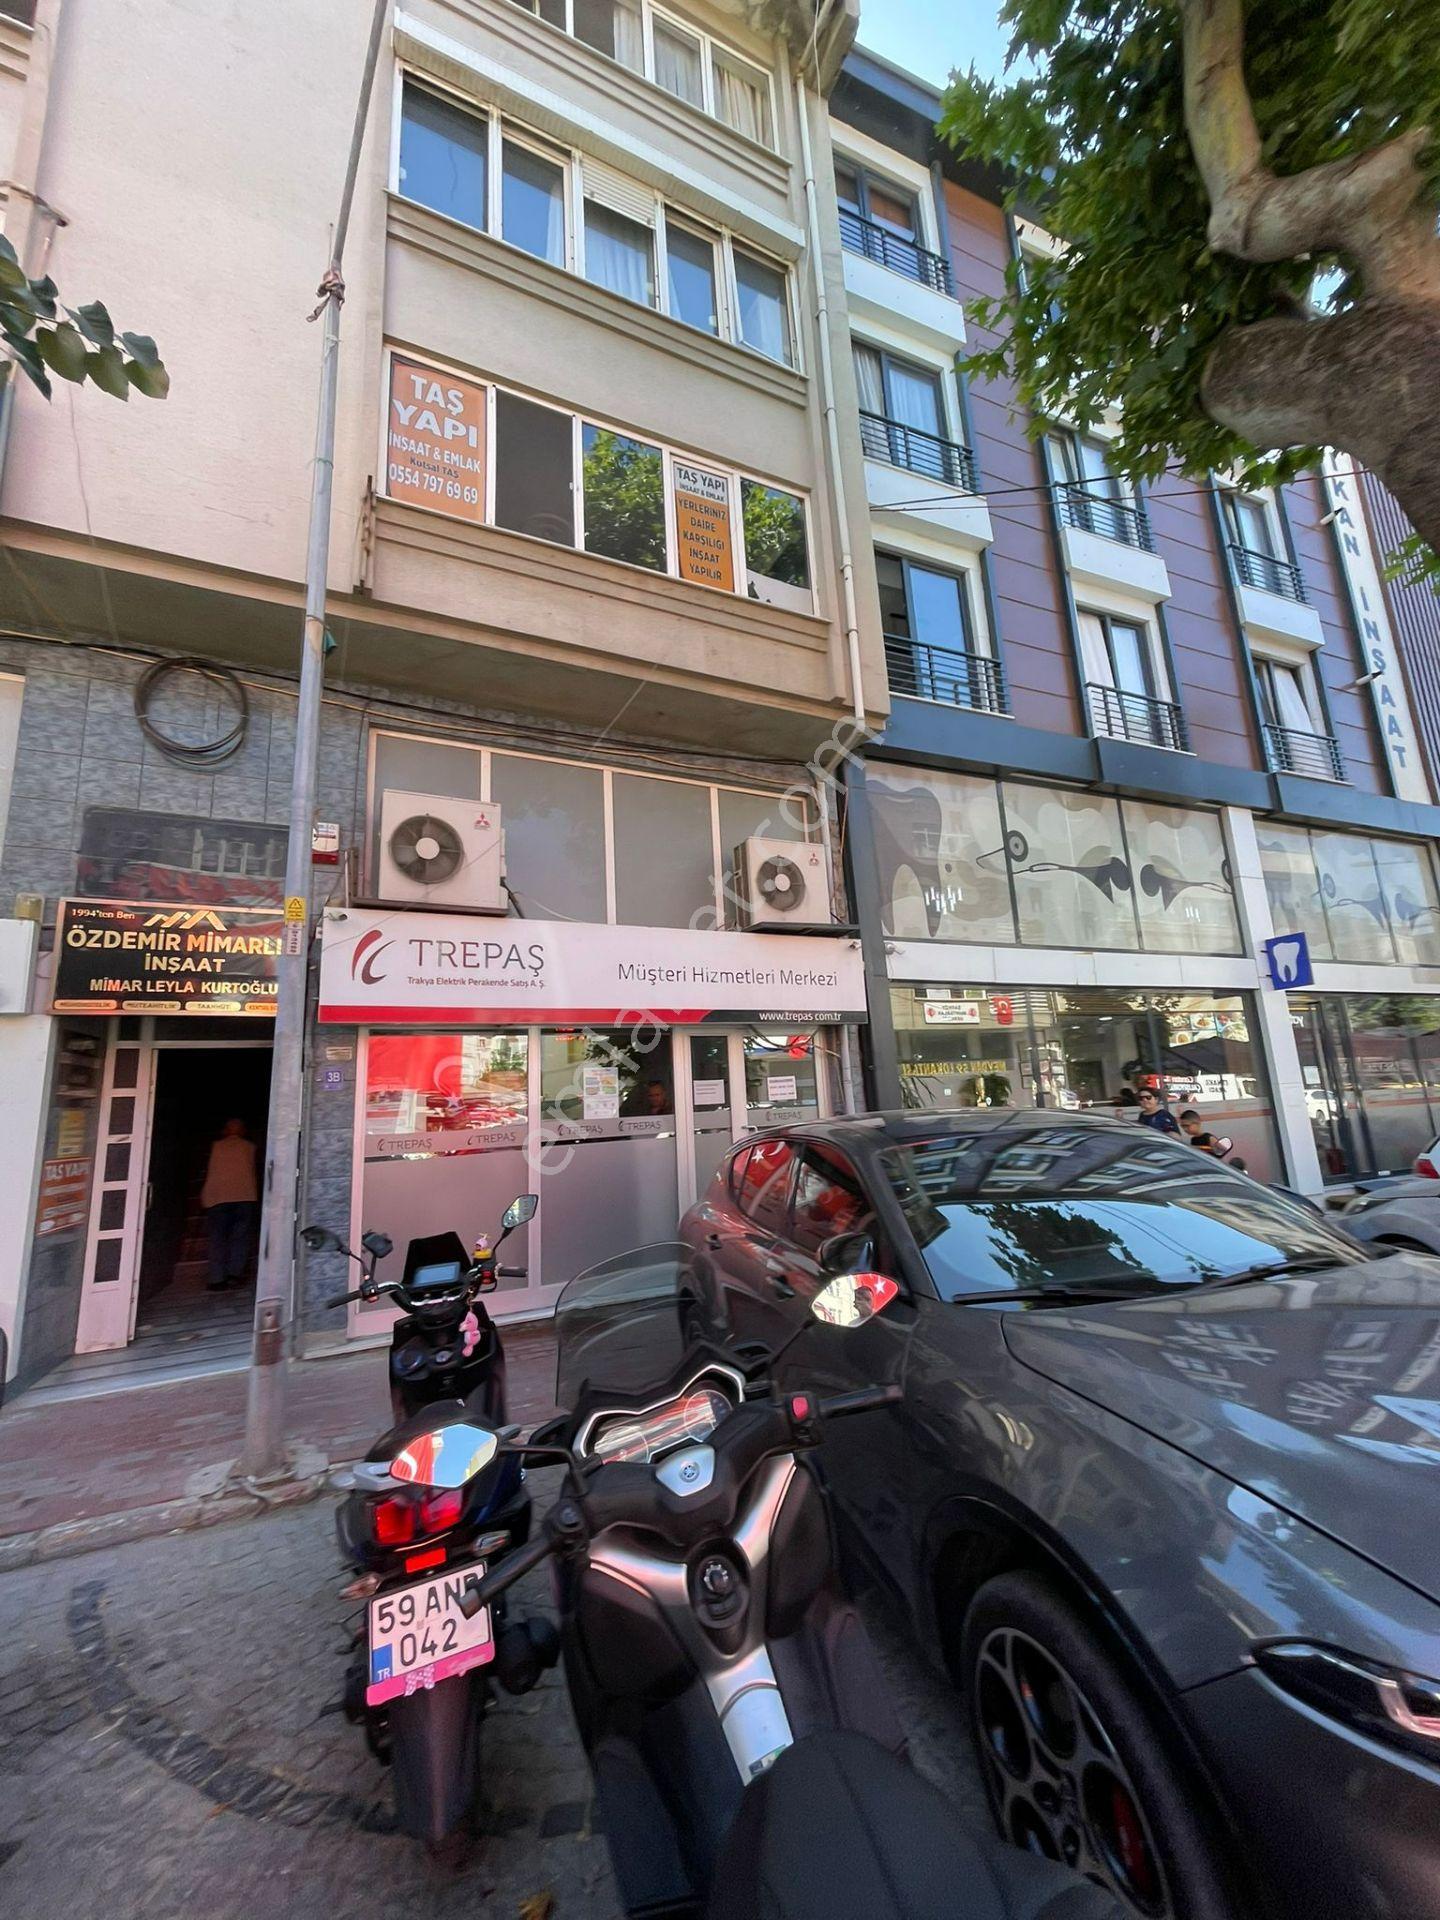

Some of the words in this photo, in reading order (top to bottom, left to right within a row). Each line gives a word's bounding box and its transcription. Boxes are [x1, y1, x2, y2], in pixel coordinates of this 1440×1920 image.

[410, 374, 465, 416] TAŞ
[392, 399, 478, 448] YAPI
[433, 446, 441, 461] &
[443, 450, 481, 474] EMLAK
[388, 463, 420, 488] 0554
[423, 473, 444, 494] 797
[446, 480, 461, 500] 69
[464, 485, 478, 504] 69
[676, 467, 698, 484] TAŞ
[700, 474, 725, 492] YAPI
[66, 924, 181, 951] ÖZDEMİR
[186, 931, 283, 956] MİMARLI
[144, 953, 226, 974] İNŞAAT
[408, 938, 545, 978] TREPAŞ
[90, 976, 143, 993] MİMAR
[146, 980, 195, 993] LEYLA
[201, 979, 279, 995] KURTOĞLU
[407, 976, 435, 986] Trakya
[436, 977, 466, 986] Elektrik
[468, 978, 509, 987] Perakende
[617, 963, 687, 986] Müşteri
[692, 965, 775, 985] Hizmetleri
[780, 969, 838, 987] Merkezi
[326, 1071, 341, 1082] 3B
[378, 1594, 416, 1634] 59
[400, 1618, 459, 1667] 042
[376, 1667, 391, 1682] TR
